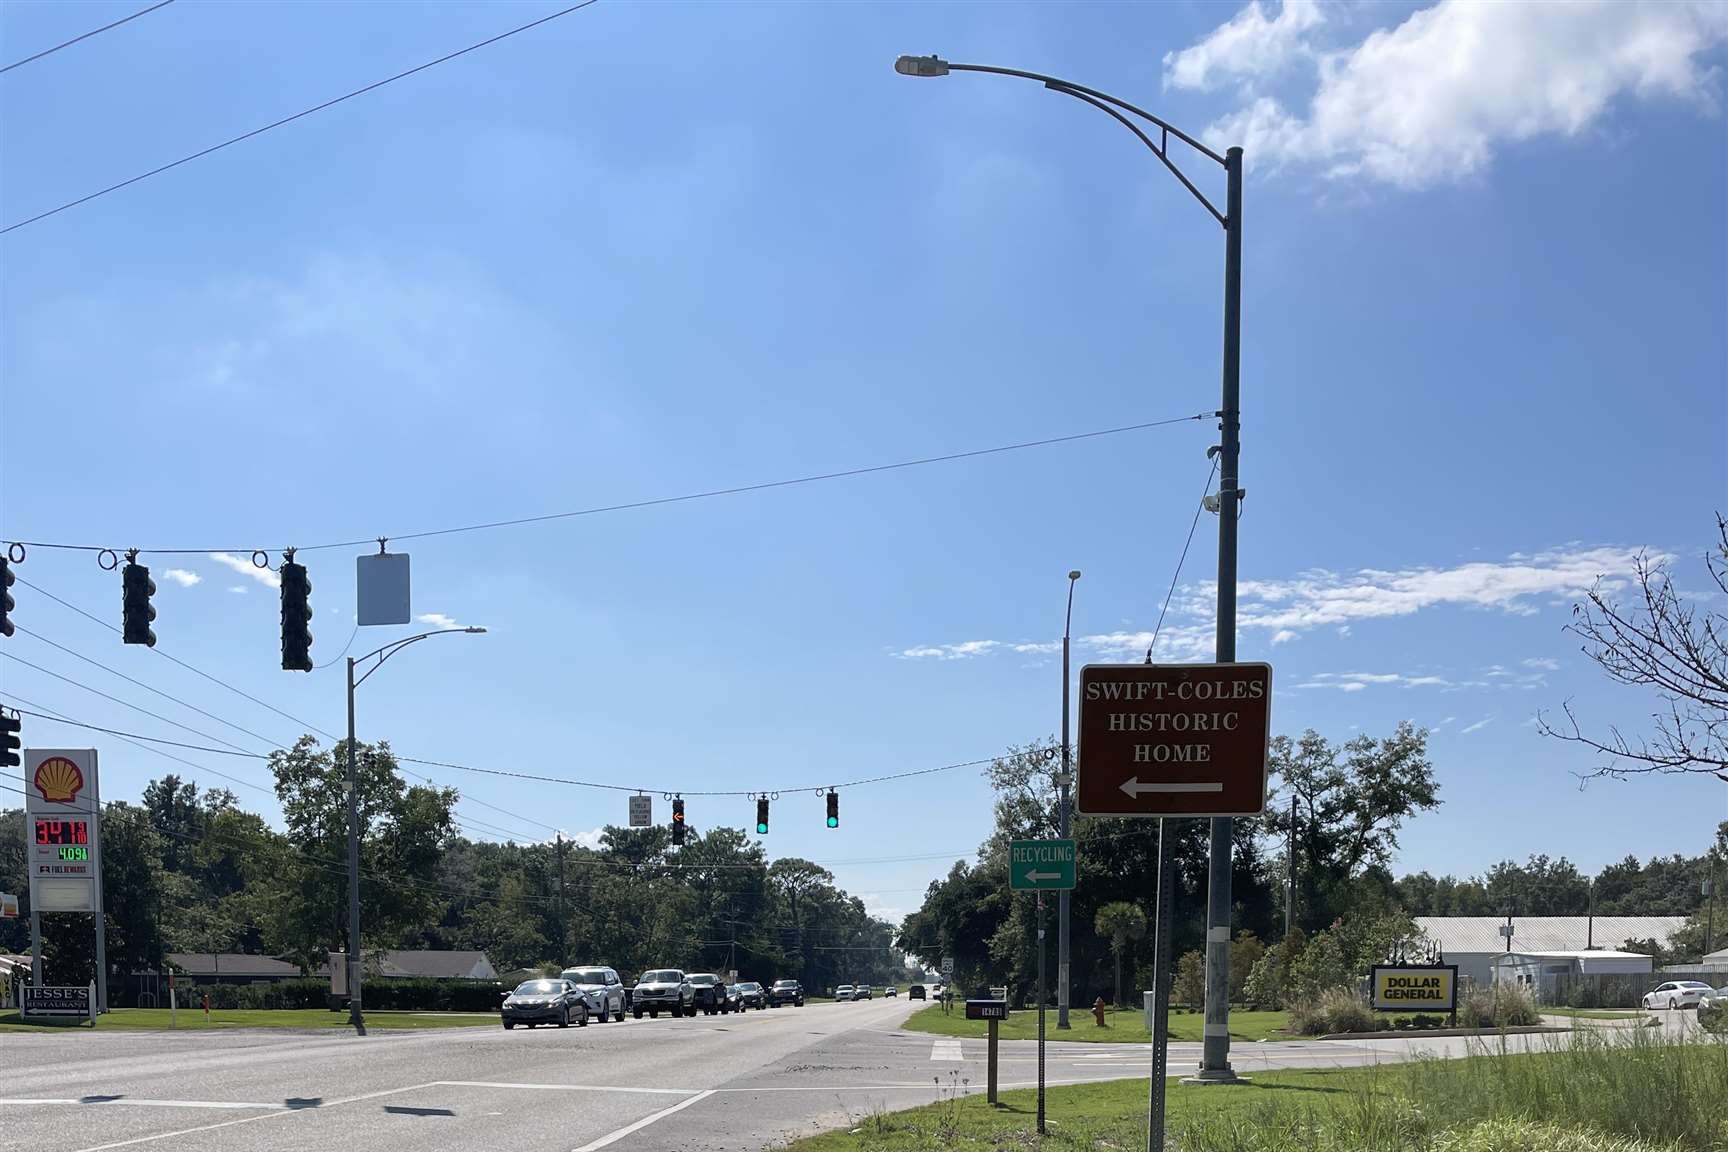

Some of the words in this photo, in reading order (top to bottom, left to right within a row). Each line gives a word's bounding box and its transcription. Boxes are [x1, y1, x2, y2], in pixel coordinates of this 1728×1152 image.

[1086, 680, 1264, 701] SWIFT-COLES
[1108, 712, 1239, 732] HISTORIC
[1133, 744, 1211, 762] HOME
[1013, 846, 1072, 863] RECYCLING
[1387, 977, 1441, 988] DOLLAR
[26, 988, 88, 999] JESSE'S
[1384, 989, 1443, 1000] GENERAL
